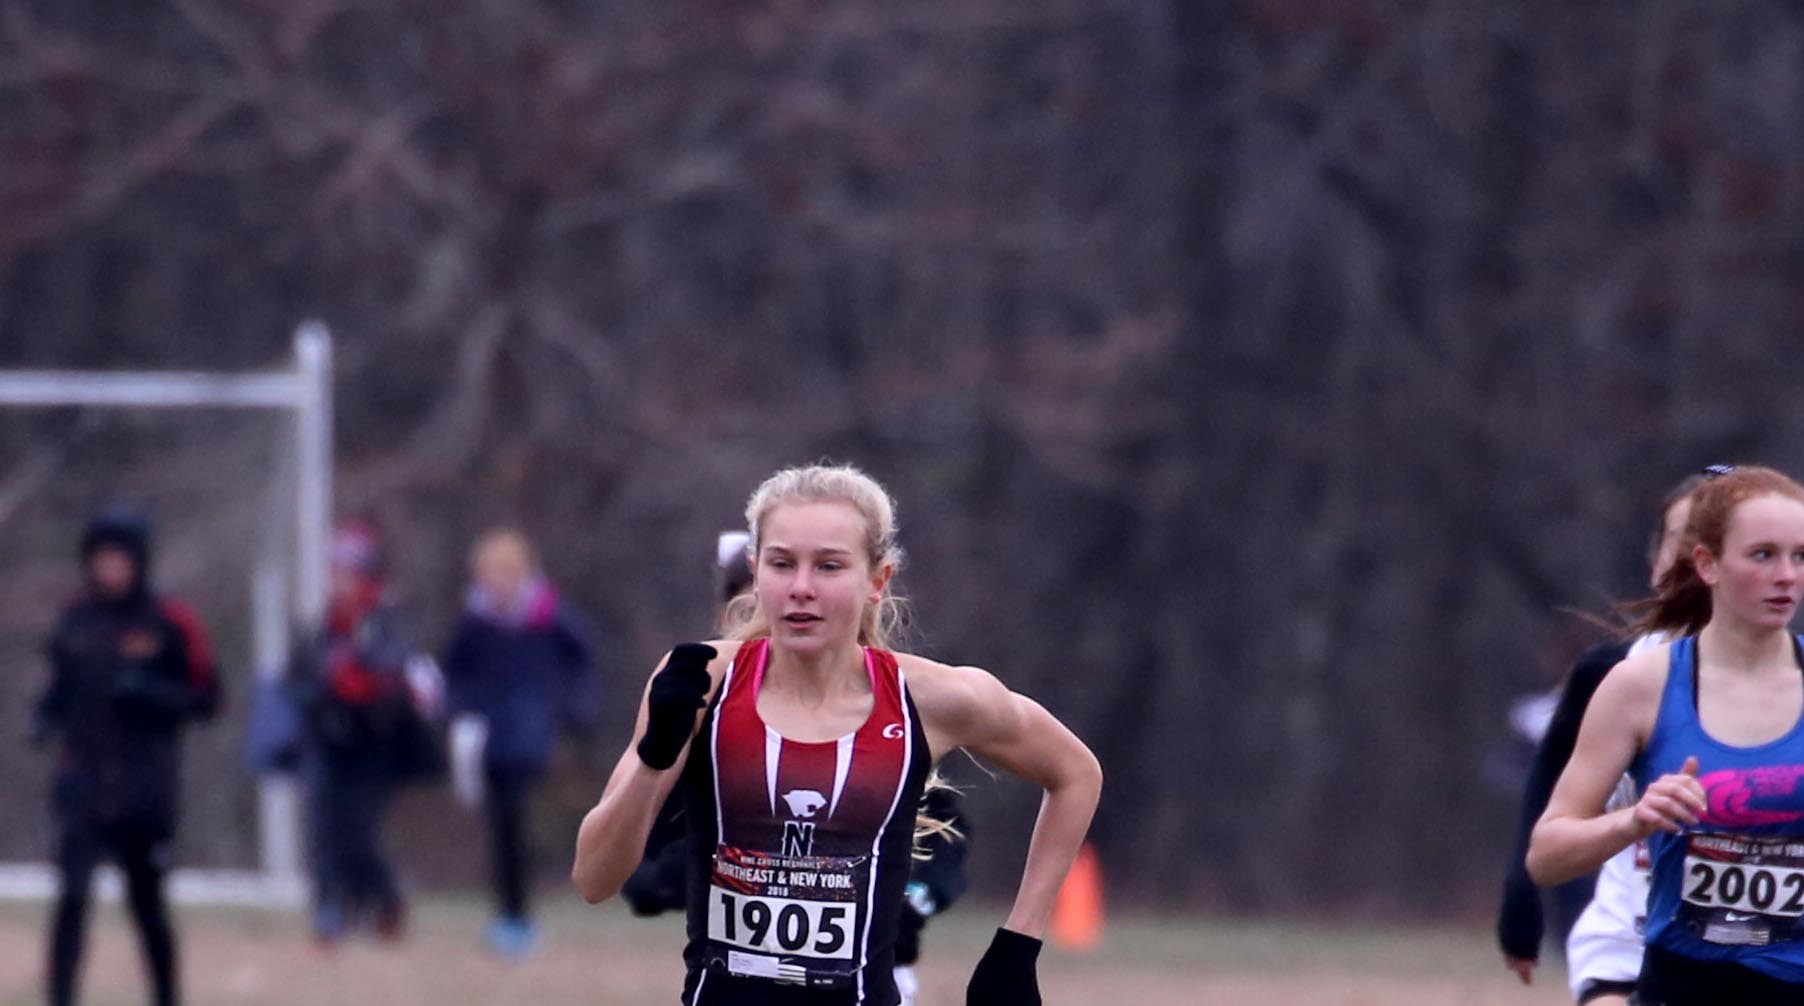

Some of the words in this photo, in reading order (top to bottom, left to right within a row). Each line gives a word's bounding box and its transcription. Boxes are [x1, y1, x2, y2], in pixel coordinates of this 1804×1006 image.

[782, 821, 815, 857] N
[717, 862, 775, 884] NORTHEAST
[777, 871, 787, 884] &
[790, 872, 817, 887] NEW
[820, 874, 851, 888] YORK
[721, 893, 845, 954] 1905
